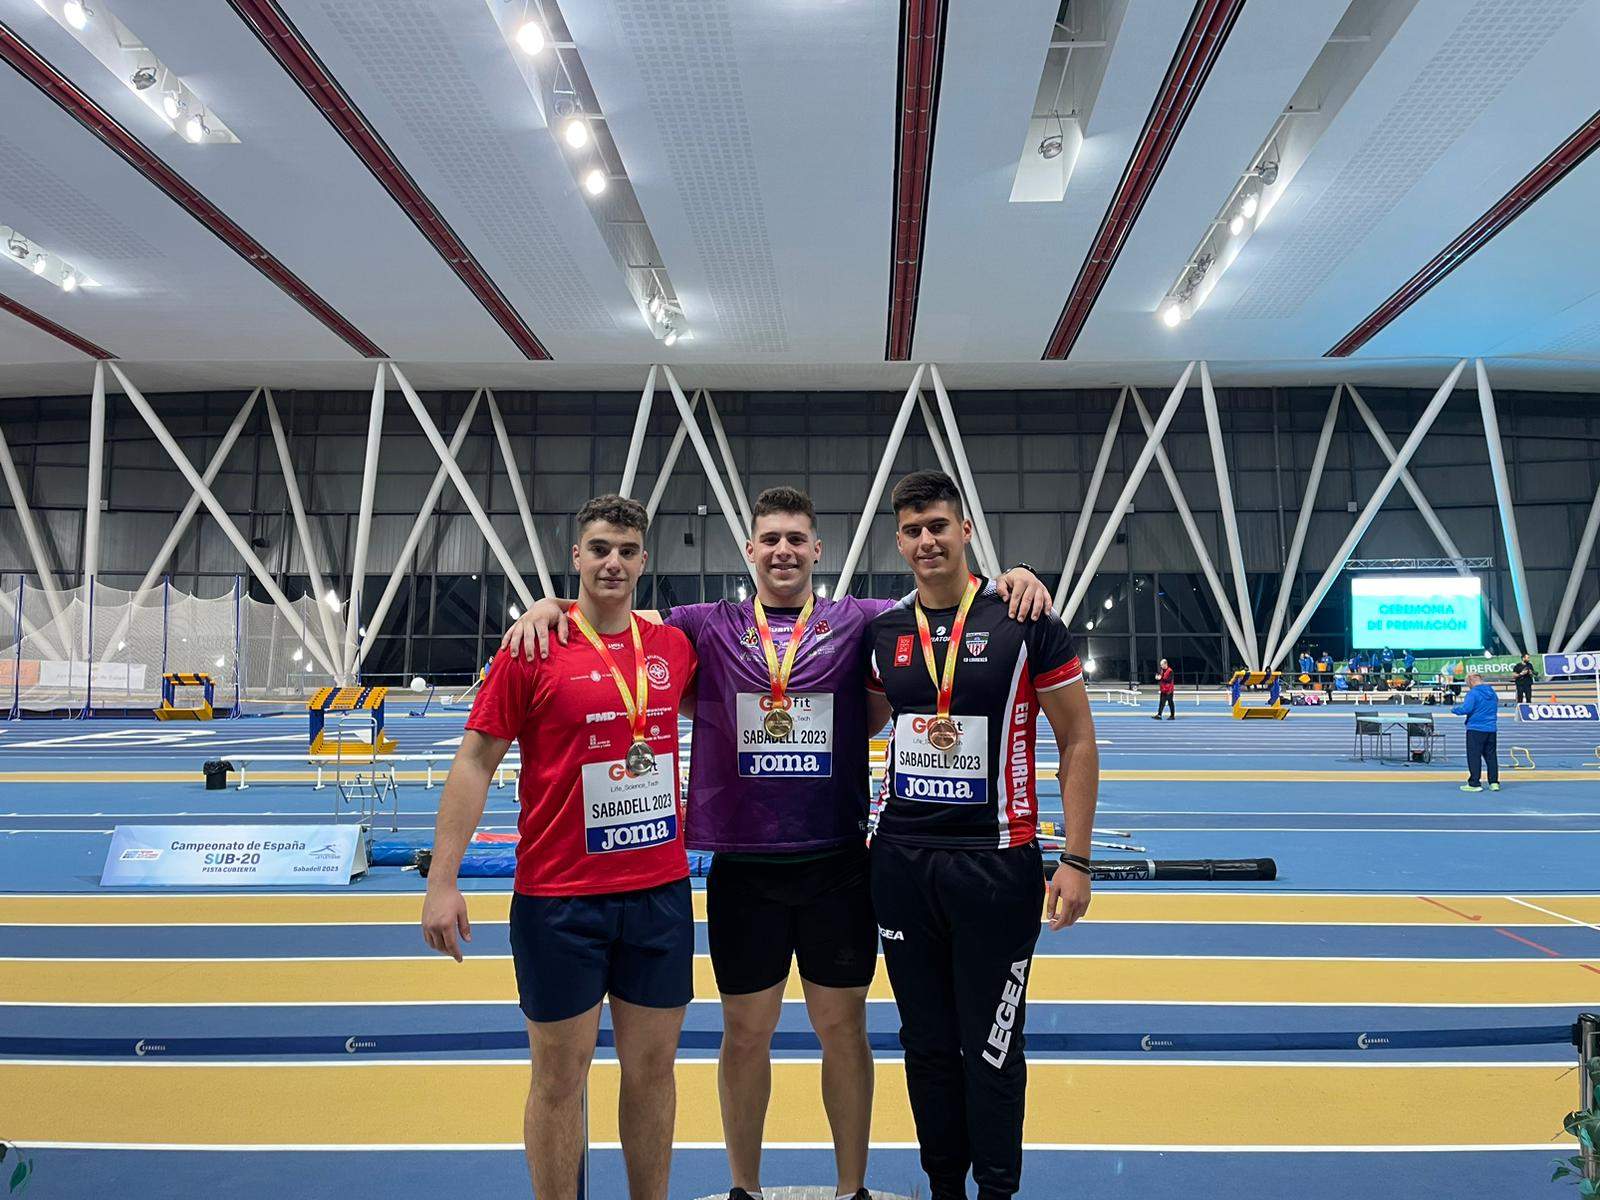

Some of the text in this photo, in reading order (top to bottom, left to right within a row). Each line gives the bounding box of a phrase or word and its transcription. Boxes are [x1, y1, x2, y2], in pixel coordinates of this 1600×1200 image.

[1379, 604, 1455, 614] CEREMONIA
[1367, 620, 1382, 630] DE
[1466, 663, 1517, 673] IBERDRO
[1016, 702, 1029, 726] ED
[1528, 704, 1592, 720] Joma
[801, 730, 827, 744] 2023
[749, 754, 820, 774] Joma
[899, 750, 981, 770] SABADELL 2023
[905, 777, 973, 799] Joma
[592, 793, 672, 819] SABADELL 2023
[602, 820, 669, 850] Joma
[171, 840, 306, 852] Campeonato de España
[204, 853, 260, 864] SUB-20
[879, 928, 904, 940] GEA
[981, 958, 1029, 1069] LEGEA
